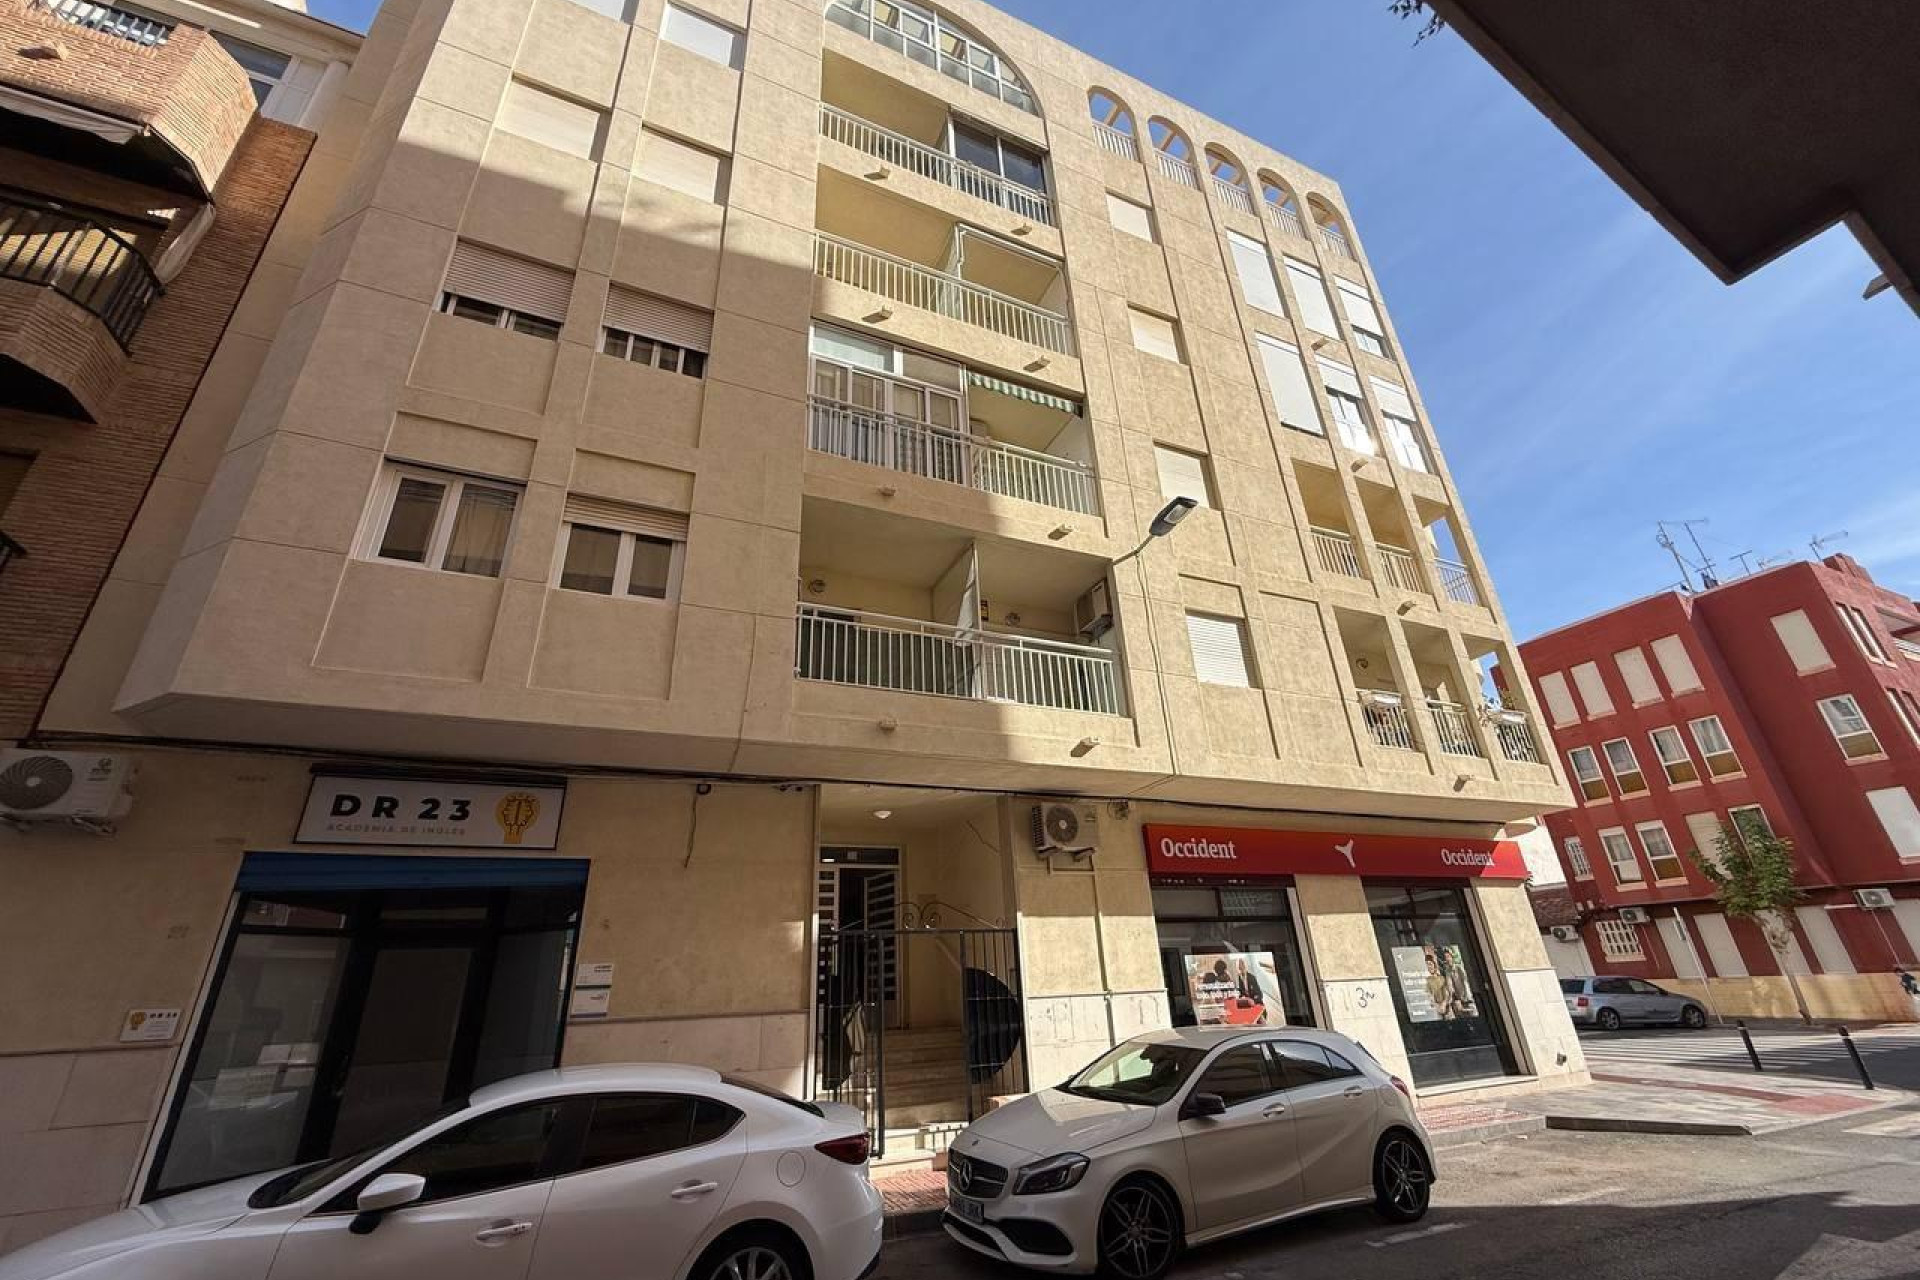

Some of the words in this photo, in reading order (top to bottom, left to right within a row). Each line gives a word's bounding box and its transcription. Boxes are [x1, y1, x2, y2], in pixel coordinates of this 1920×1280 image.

[330, 794, 399, 819] DR
[418, 798, 471, 821] 23
[326, 823, 394, 833] ACADEMIA
[398, 824, 416, 834] DE
[1160, 837, 1237, 859] Occident
[1441, 848, 1495, 866] Occident
